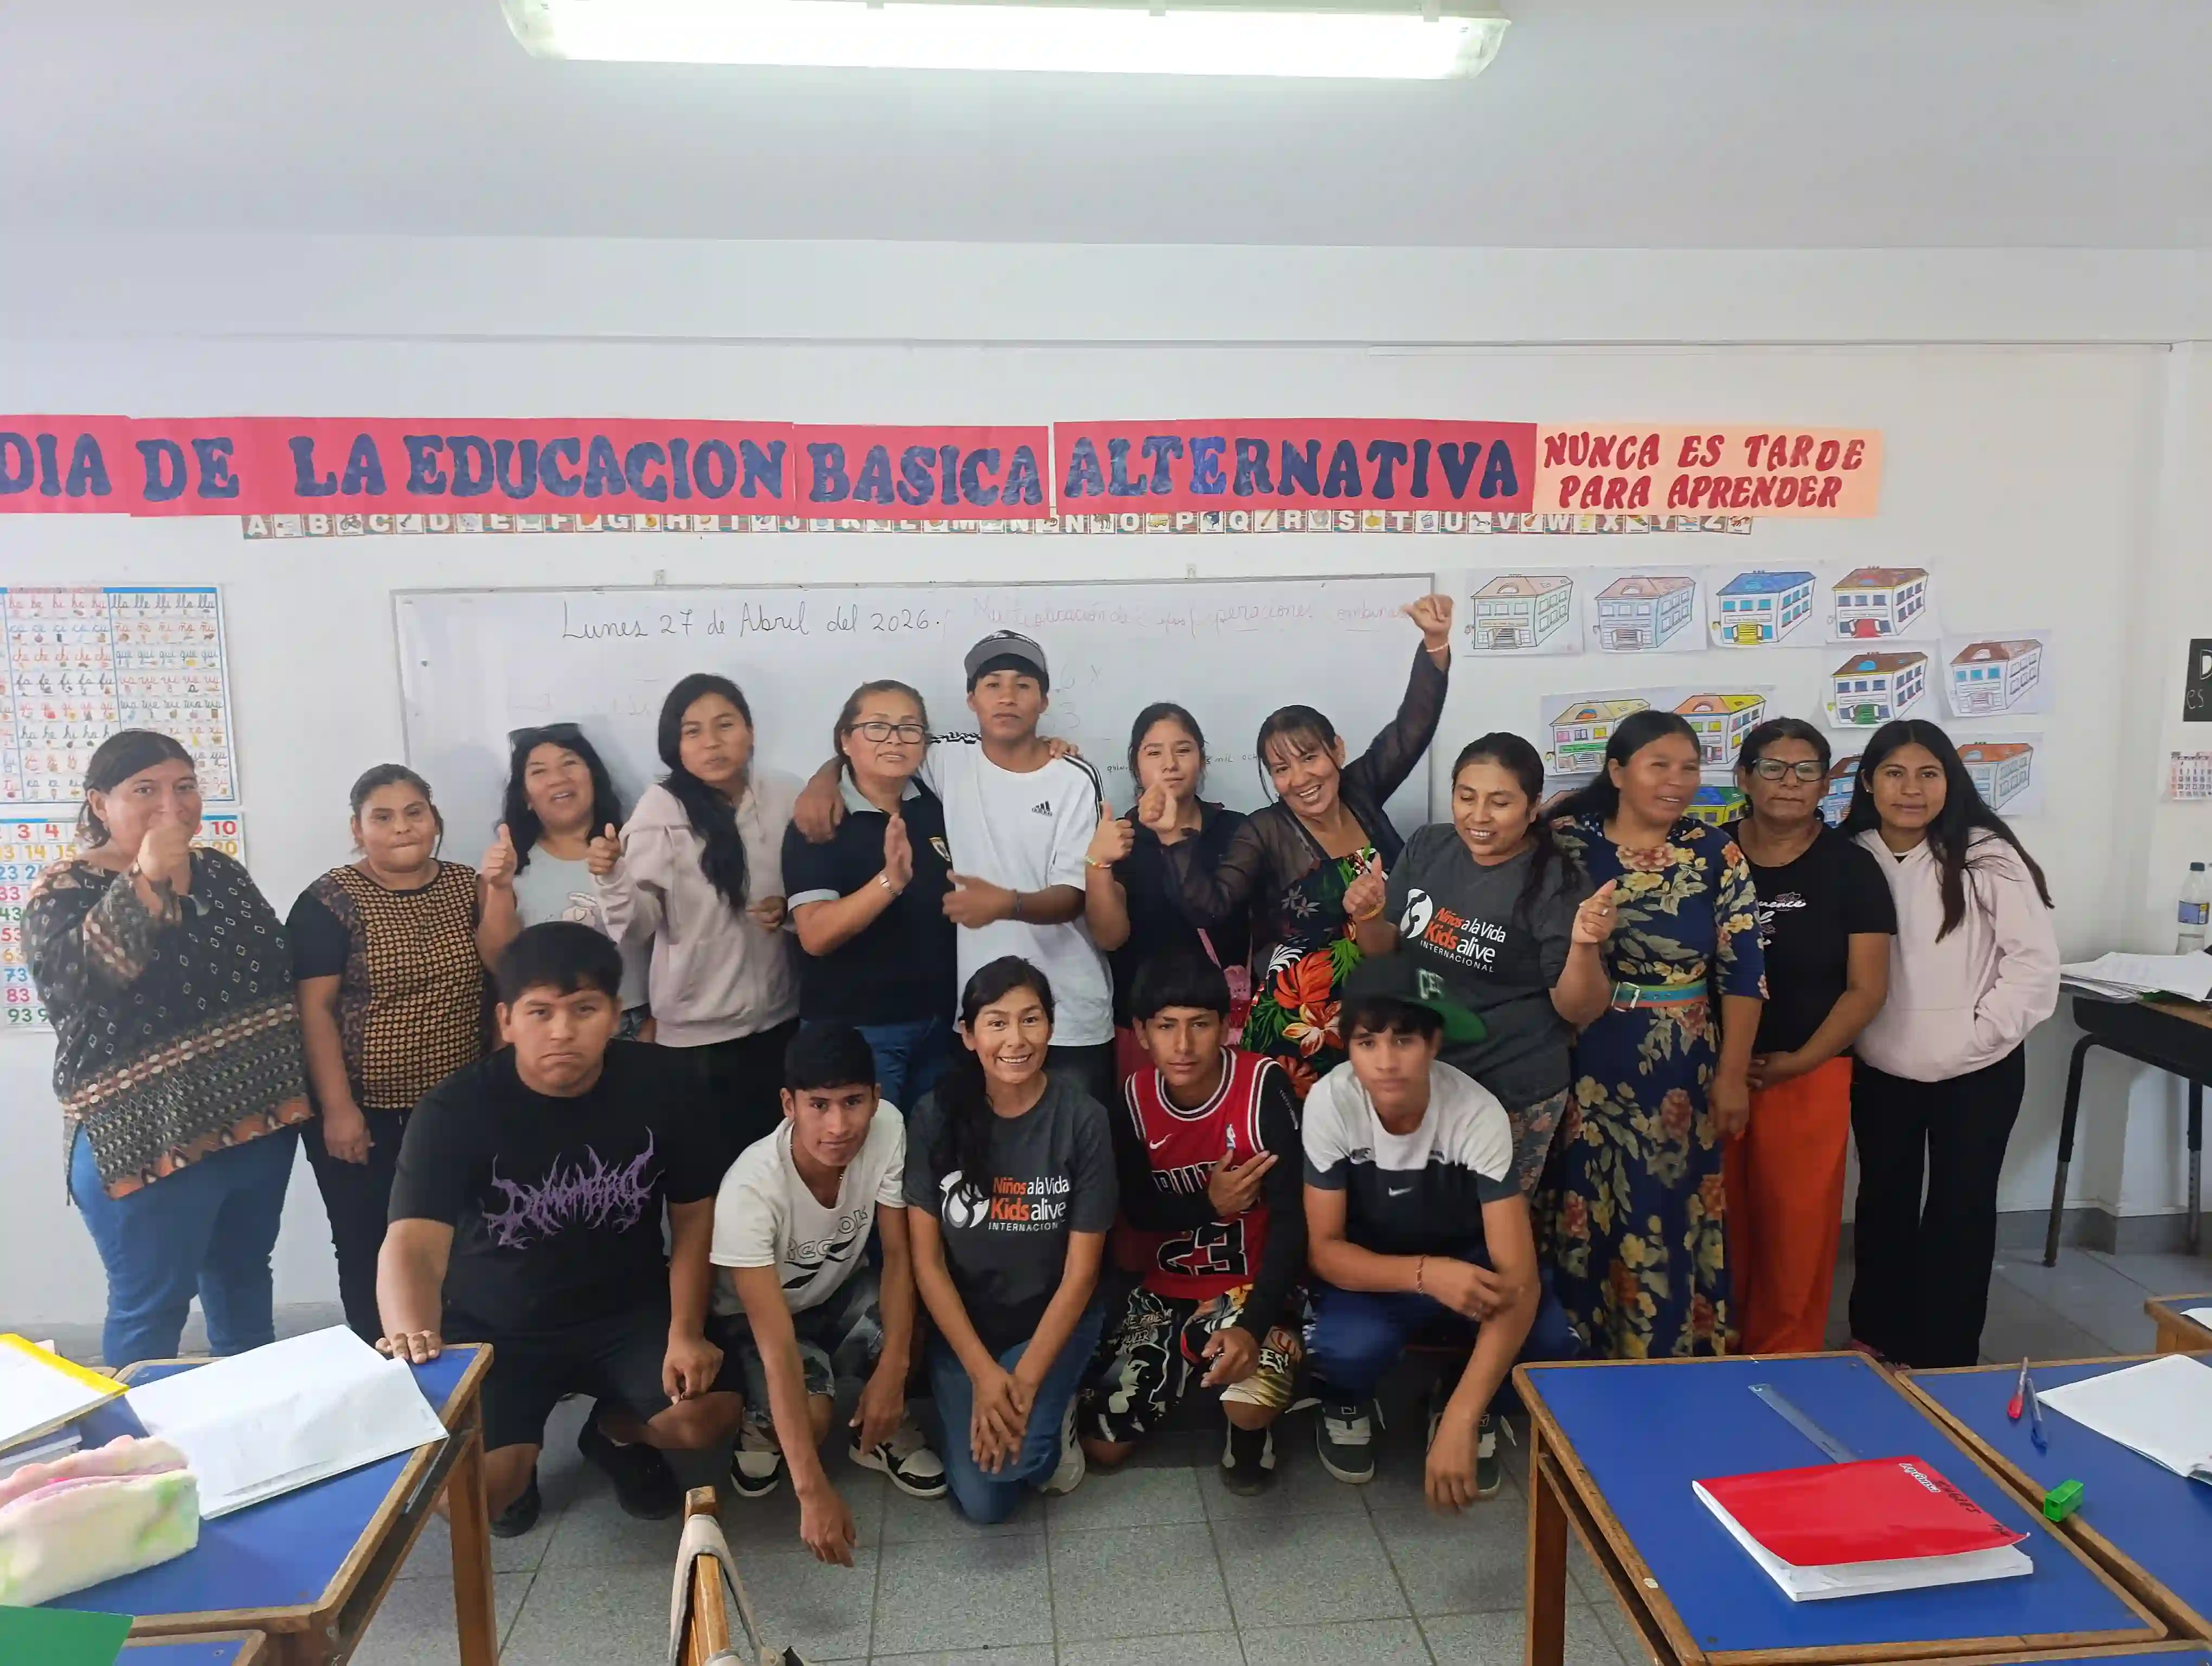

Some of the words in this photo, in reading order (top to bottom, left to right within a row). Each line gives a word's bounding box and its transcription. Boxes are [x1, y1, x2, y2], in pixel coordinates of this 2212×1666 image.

[1544, 432, 1660, 470] NUNCA
[1677, 434, 1725, 468] ES
[1745, 433, 1864, 472] TARDE
[0, 432, 112, 497] DIA
[137, 438, 239, 502] DE
[290, 434, 387, 497] LA
[403, 435, 786, 502] EDUCACION
[807, 443, 1043, 506] BASICA
[1064, 435, 1517, 499] ALTERNATIVA
[1559, 475, 1651, 510] PARA
[1667, 474, 1842, 509] APRENDER
[248, 515, 268, 536] A
[309, 515, 330, 535] B
[369, 514, 390, 533] C
[430, 514, 449, 531] D
[491, 515, 509, 530] E
[552, 515, 567, 529] F
[608, 515, 628, 529] G
[666, 515, 686, 530] H
[785, 515, 800, 530] J
[1121, 512, 1140, 531] O
[1176, 511, 1193, 531] P
[1229, 510, 1249, 531] Q
[1285, 510, 1303, 530] R
[1338, 510, 1355, 531] S
[1390, 511, 1410, 531] T
[1444, 511, 1463, 531] U
[1497, 512, 1514, 530] V
[1549, 514, 1572, 531] W
[1603, 514, 1619, 531] X
[1704, 515, 1723, 530] Z
[563, 599, 648, 639] Lunes
[660, 608, 693, 635] 27
[707, 607, 726, 636] de
[739, 600, 811, 638] Abril
[826, 603, 858, 632] del
[17, 824, 30, 838] 3
[46, 824, 59, 838] 4
[211, 821, 236, 835] 10
[25, 844, 46, 862] 14
[56, 844, 76, 860] 15
[0, 907, 22, 921] 43
[1434, 907, 1465, 928] Niños
[1460, 920, 1470, 931] a
[1468, 918, 1480, 935] la
[1480, 921, 1507, 943] Vida
[1, 927, 22, 942] 53
[1424, 921, 1459, 950] Kids
[1456, 936, 1496, 964] alive
[1420, 940, 1495, 973] INTERNACIONAL
[4, 967, 27, 982] 73
[7, 988, 30, 1003] 83
[8, 1008, 33, 1023] 93
[993, 1176, 1027, 1195] Niños
[1027, 1181, 1035, 1195] a
[1034, 1176, 1045, 1195] la
[1045, 1175, 1070, 1195] Vida
[991, 1196, 1030, 1221] Kids
[1030, 1197, 1067, 1221] alive
